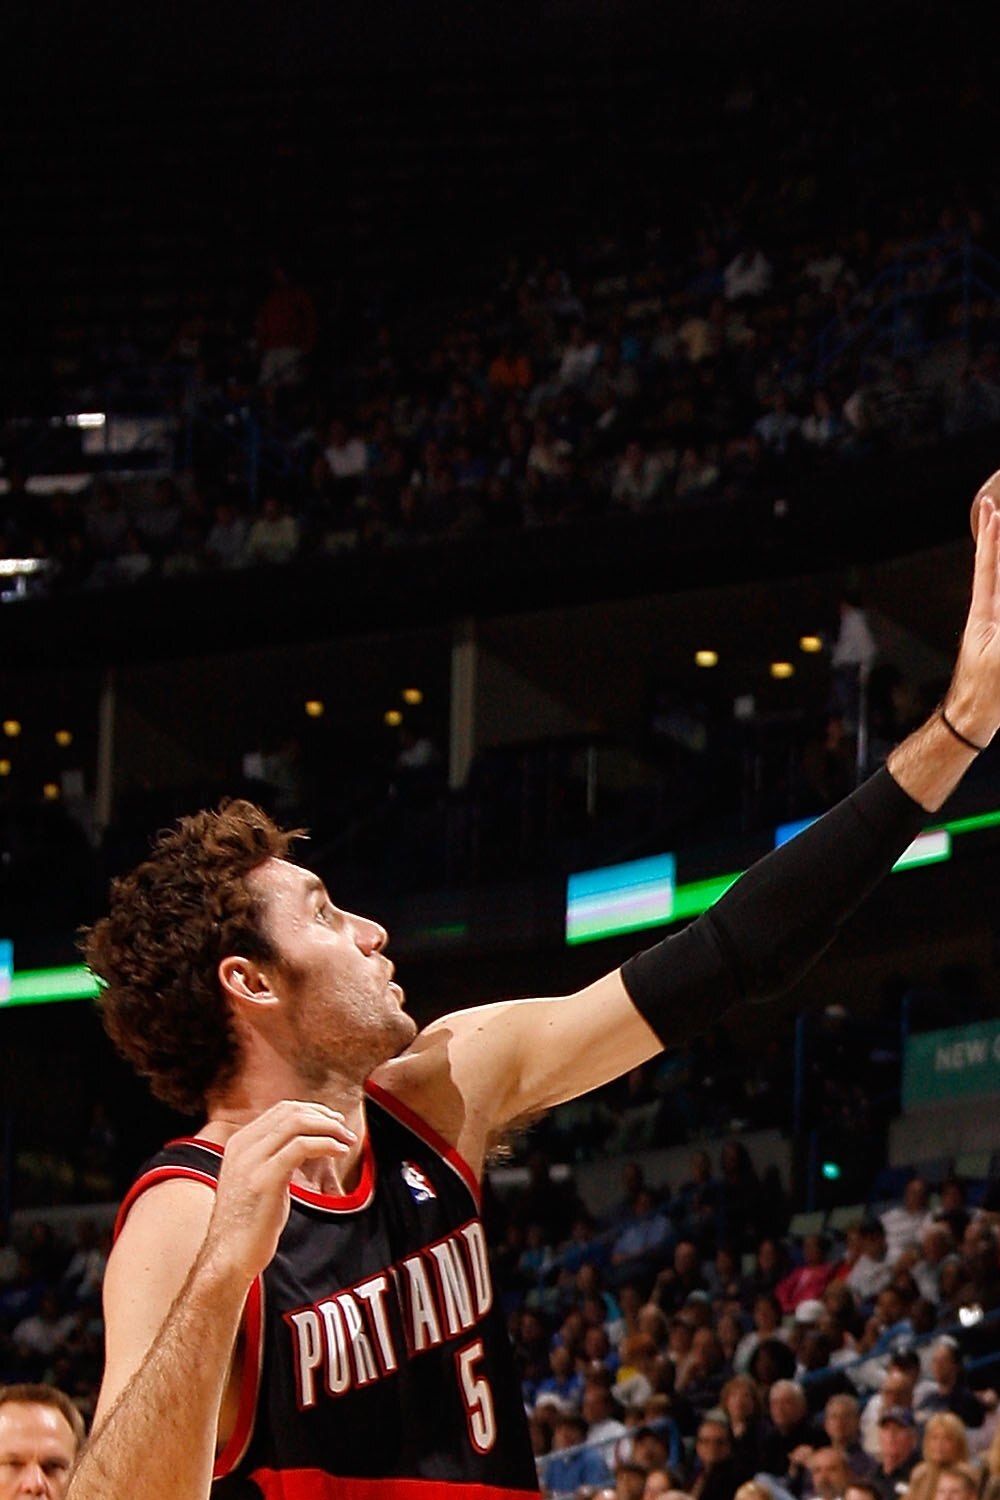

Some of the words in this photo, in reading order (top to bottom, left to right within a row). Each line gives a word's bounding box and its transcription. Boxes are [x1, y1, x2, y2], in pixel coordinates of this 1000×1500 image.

[934, 1037, 987, 1070] NEW
[285, 1219, 491, 1409] PORTAND
[455, 1339, 497, 1454] 5
